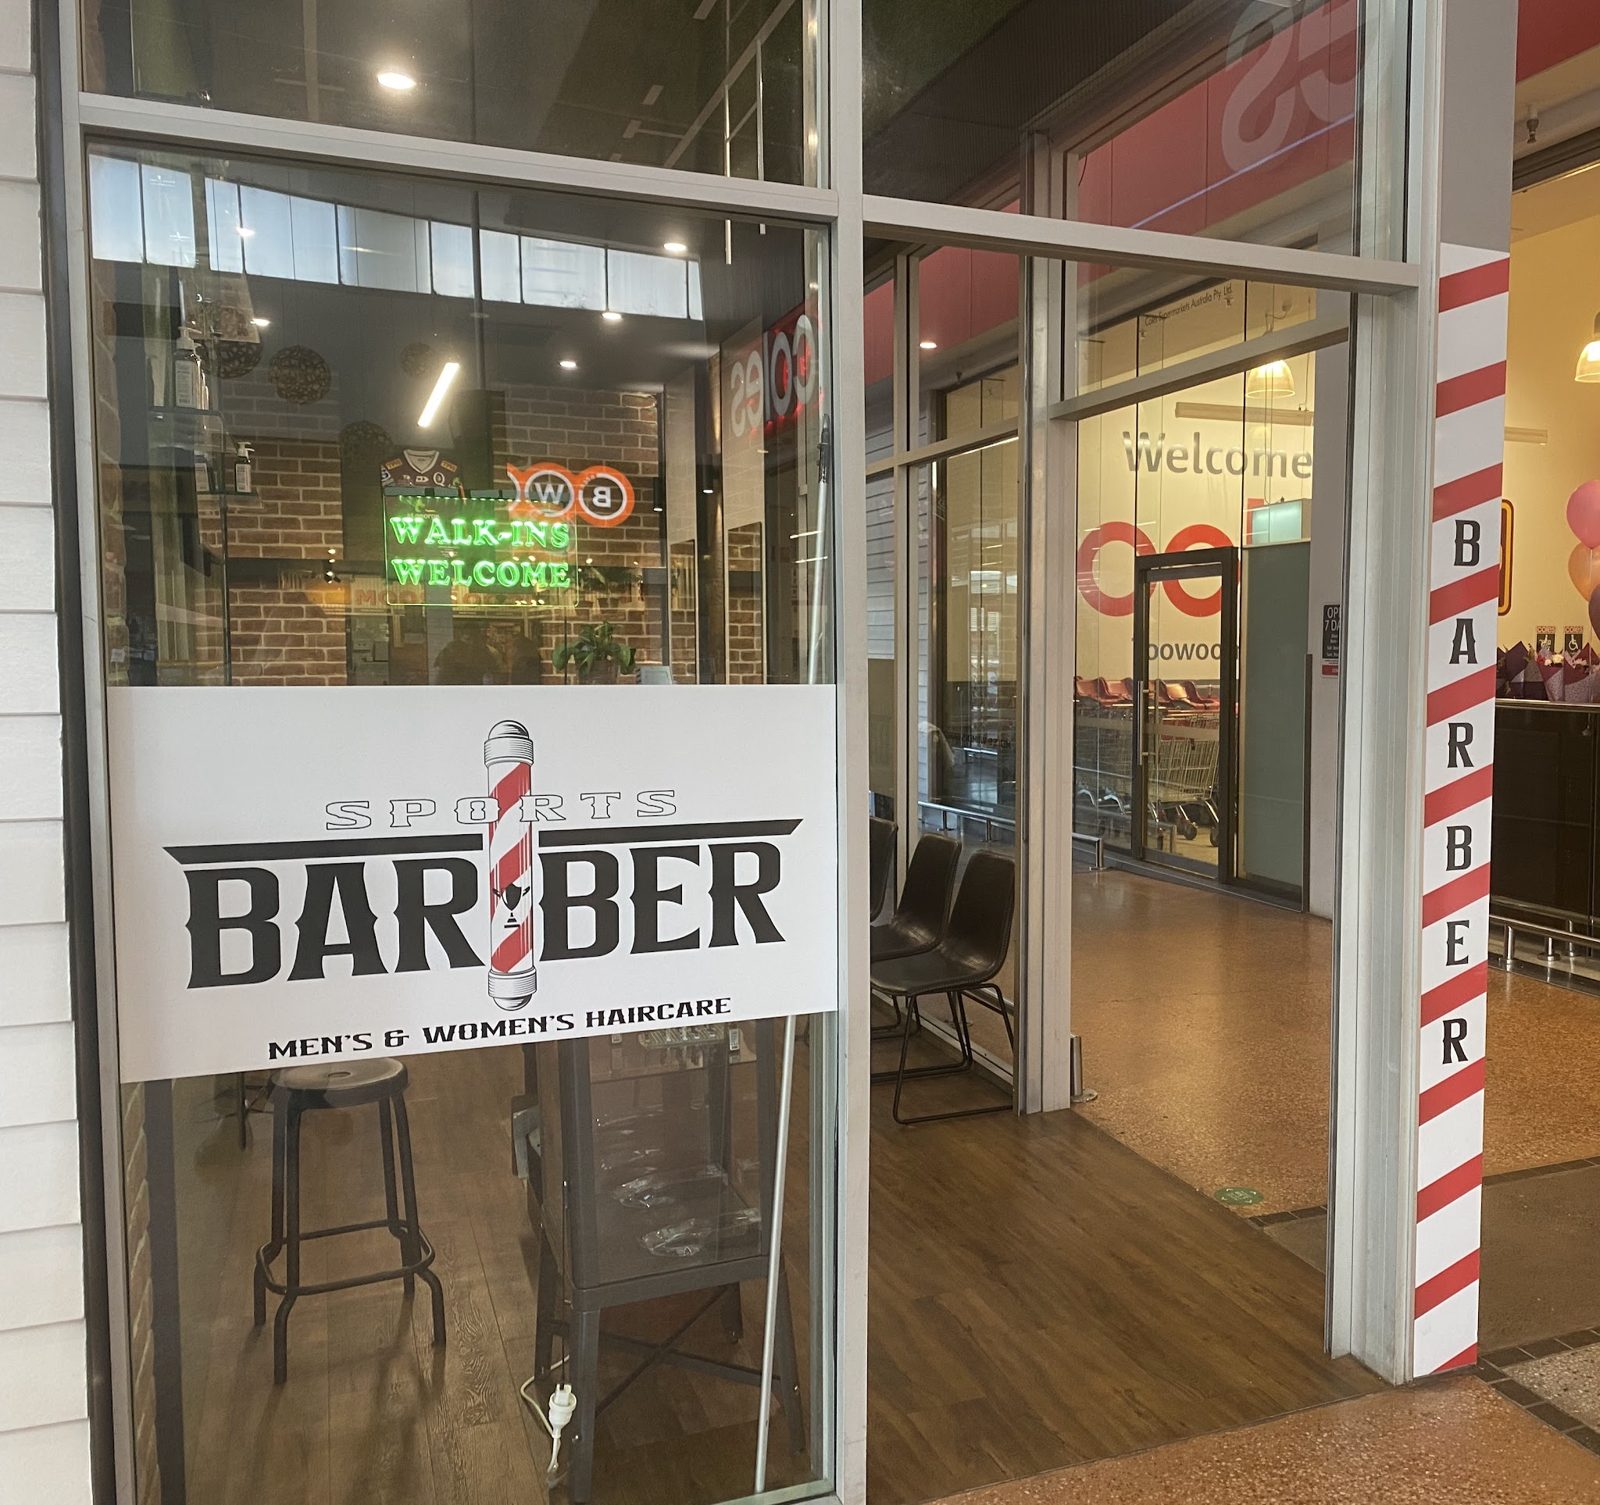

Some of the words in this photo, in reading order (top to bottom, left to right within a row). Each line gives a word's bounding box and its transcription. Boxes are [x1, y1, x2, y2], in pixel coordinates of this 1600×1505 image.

[1122, 431, 1312, 478] Welcome
[389, 516, 569, 548] WALK-INS
[391, 558, 570, 588] WELCOME
[325, 789, 677, 830] SPORTS
[1442, 519, 1480, 1064] BARBER
[186, 842, 785, 989] BARBER
[268, 1033, 373, 1060] MEN'S
[385, 1029, 409, 1048] &
[423, 1013, 575, 1044] WOMEN'S
[586, 997, 731, 1028] HAIRCARE
